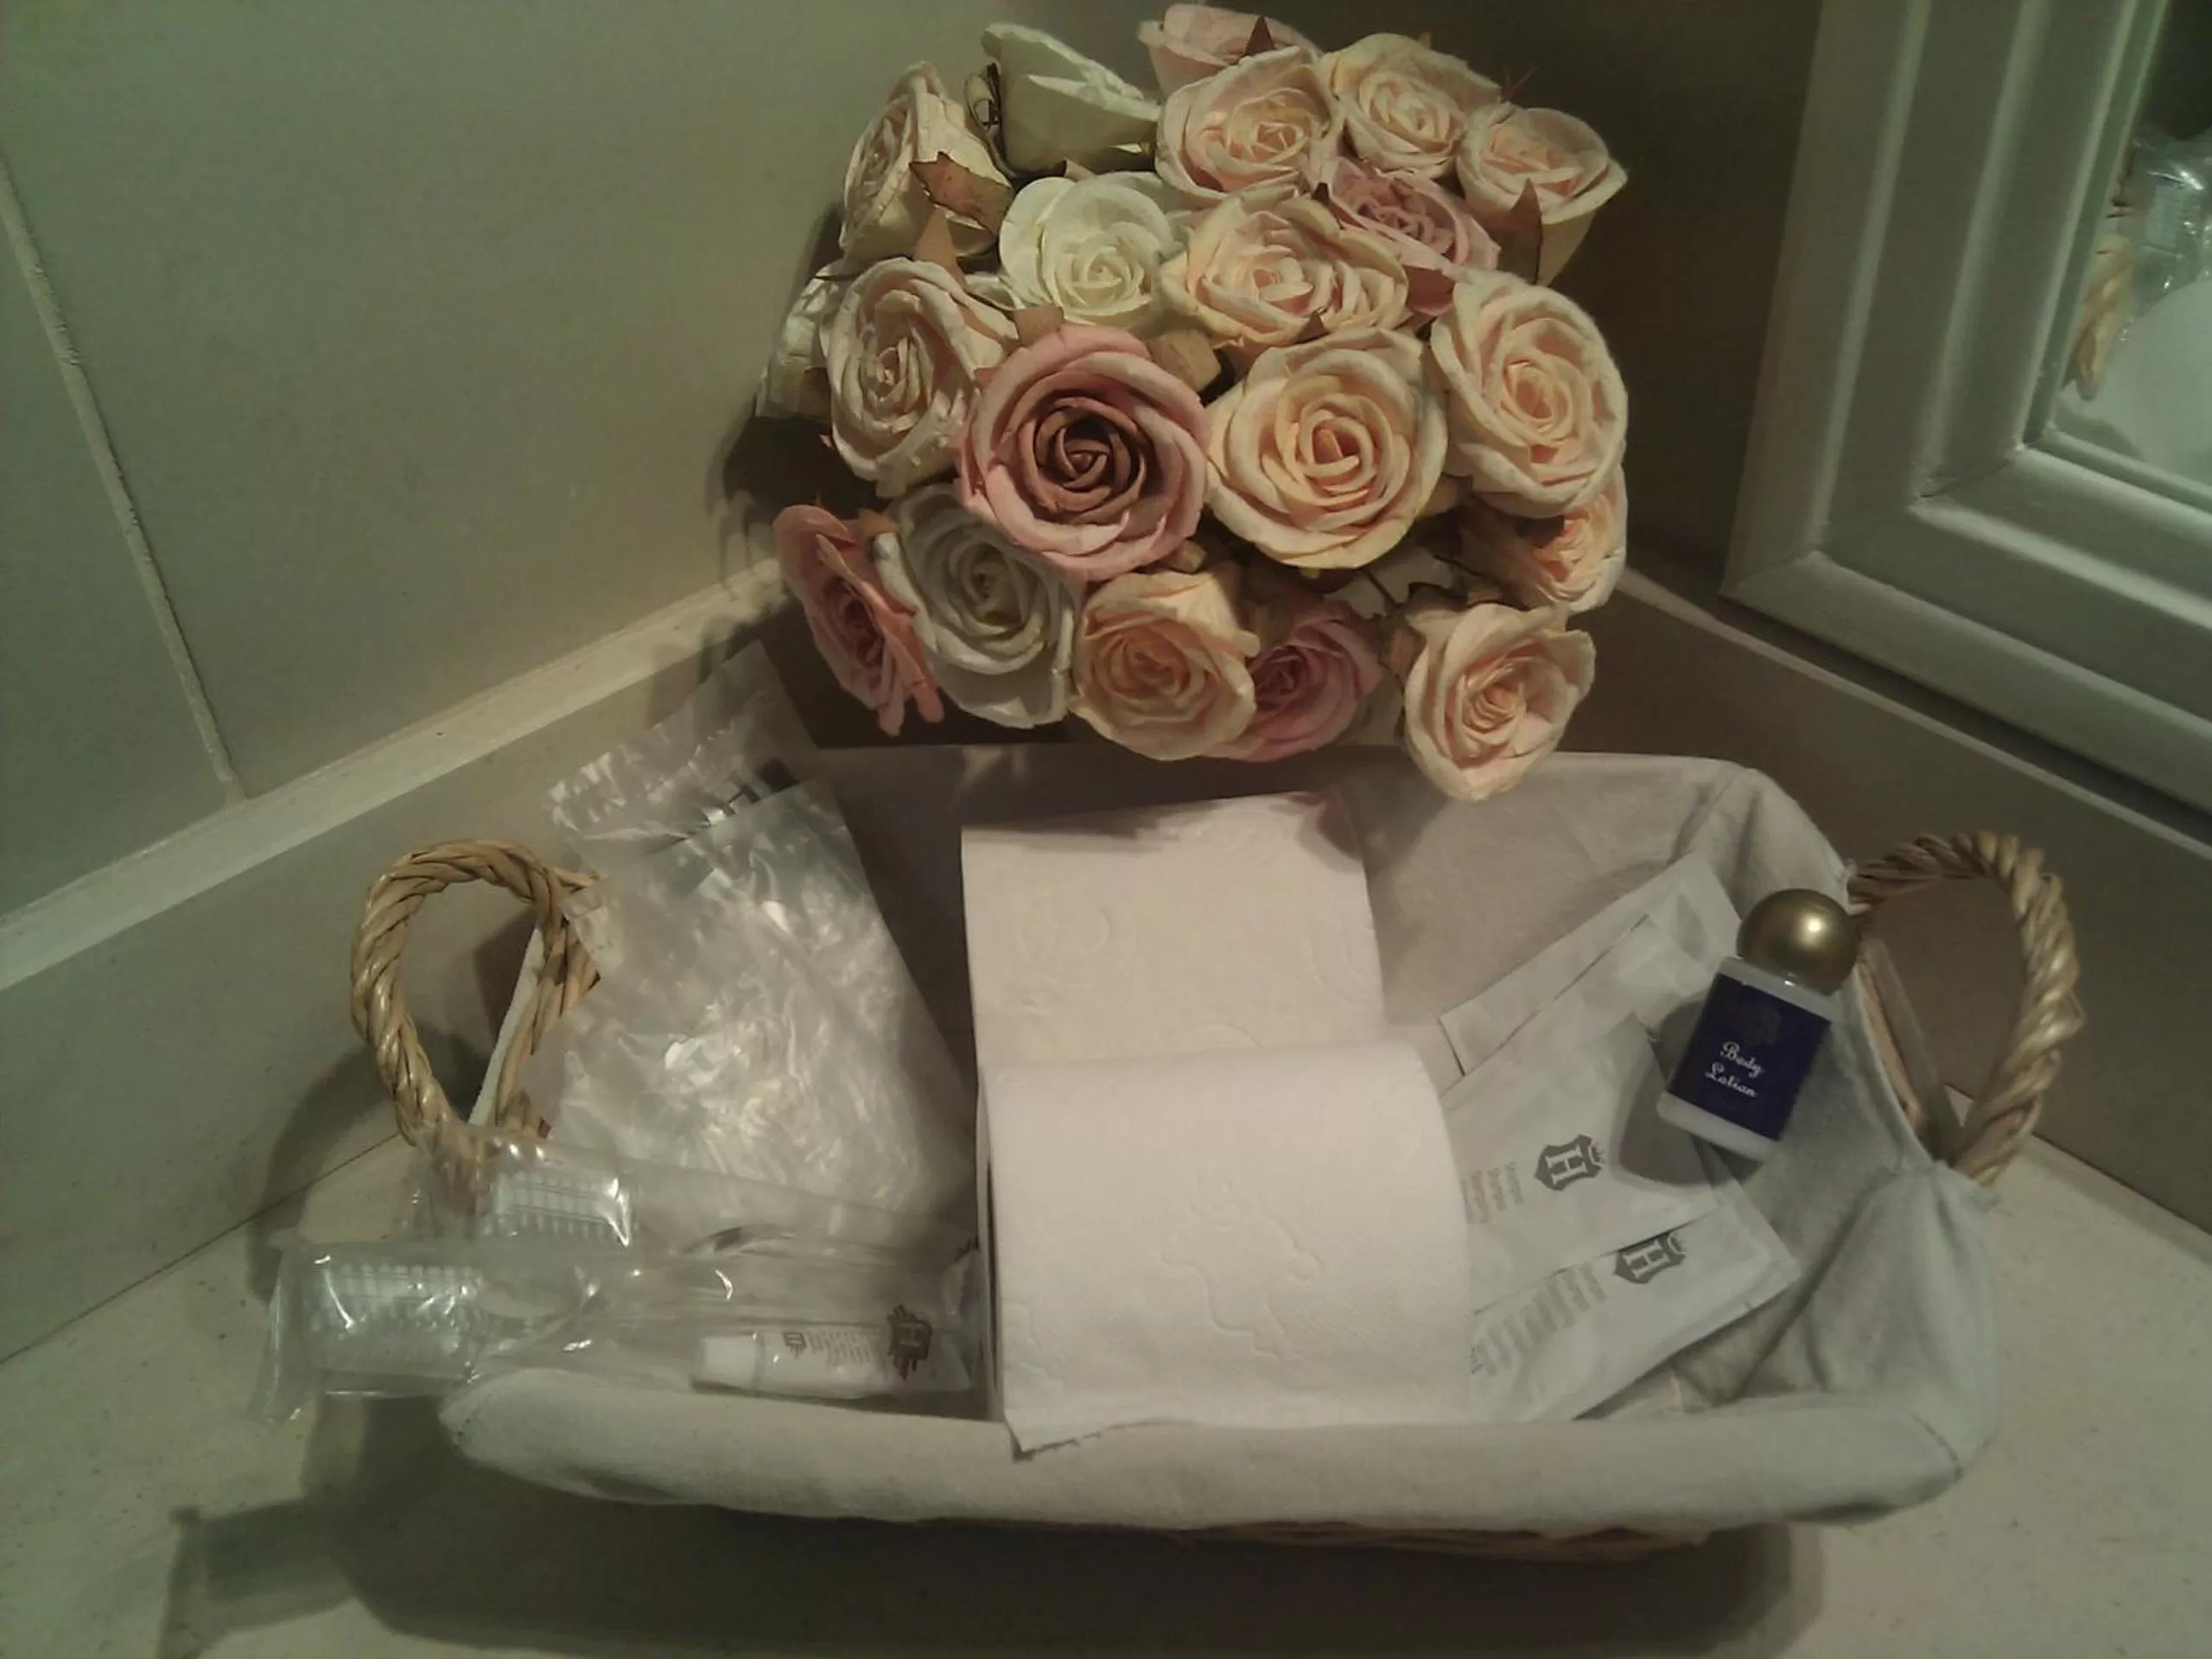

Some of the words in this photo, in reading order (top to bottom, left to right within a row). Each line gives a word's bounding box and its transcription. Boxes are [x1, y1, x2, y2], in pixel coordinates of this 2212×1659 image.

[1720, 1040, 1764, 1078] Body
[1705, 1061, 1758, 1097] Lotion
[1544, 1143, 1588, 1185] H
[1622, 1238, 1670, 1279] H
